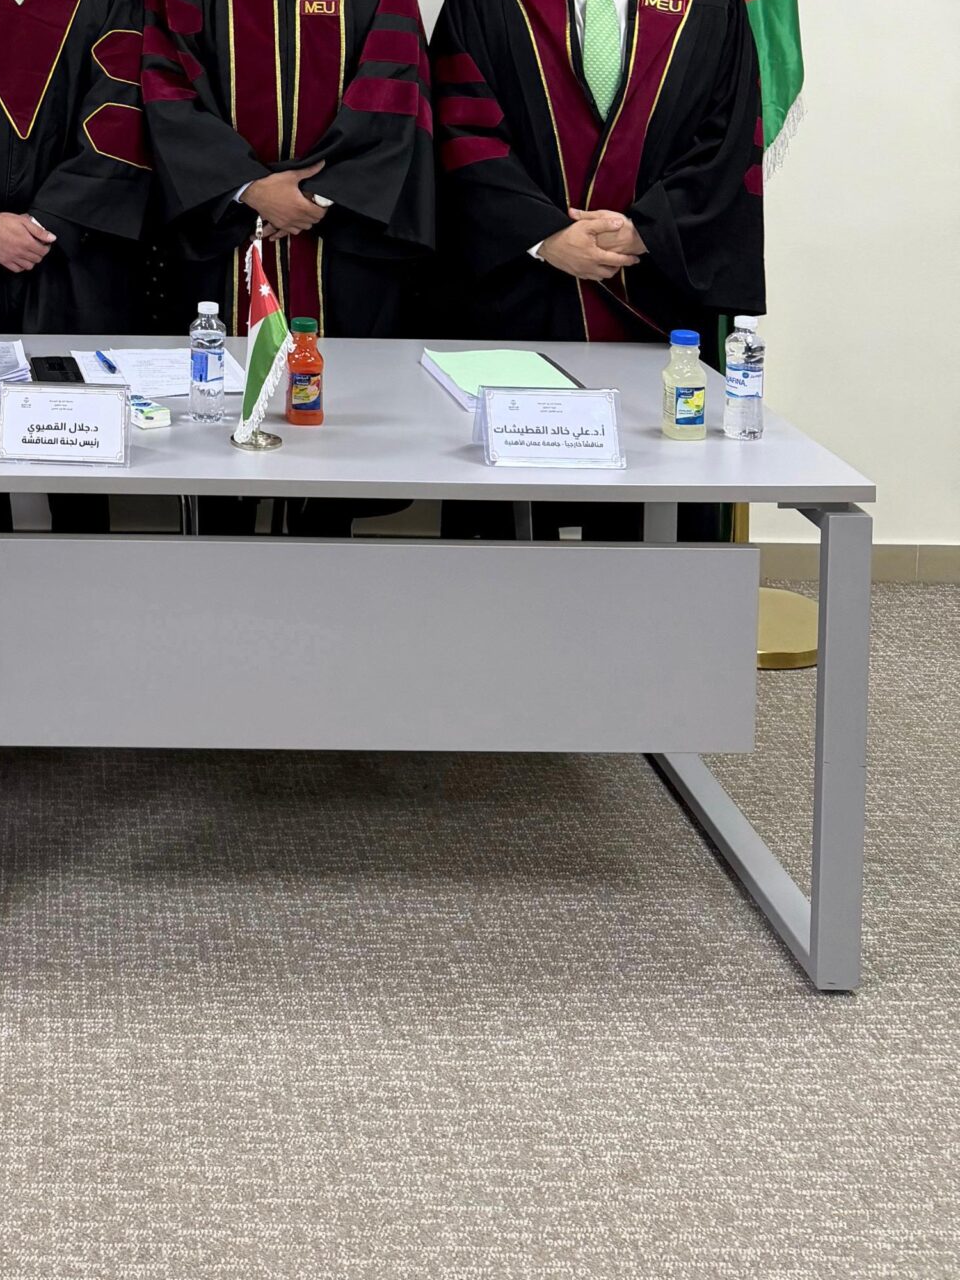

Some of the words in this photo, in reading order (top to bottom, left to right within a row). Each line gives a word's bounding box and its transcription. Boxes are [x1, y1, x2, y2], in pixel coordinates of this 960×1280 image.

[304, 0, 336, 14] MEU
[493, 423, 549, 437] القطيشات
[550, 425, 570, 436] خالد
[21, 434, 59, 447] المناقشة
[59, 437, 78, 447] لجنة
[78, 436, 100, 448] رئيس
